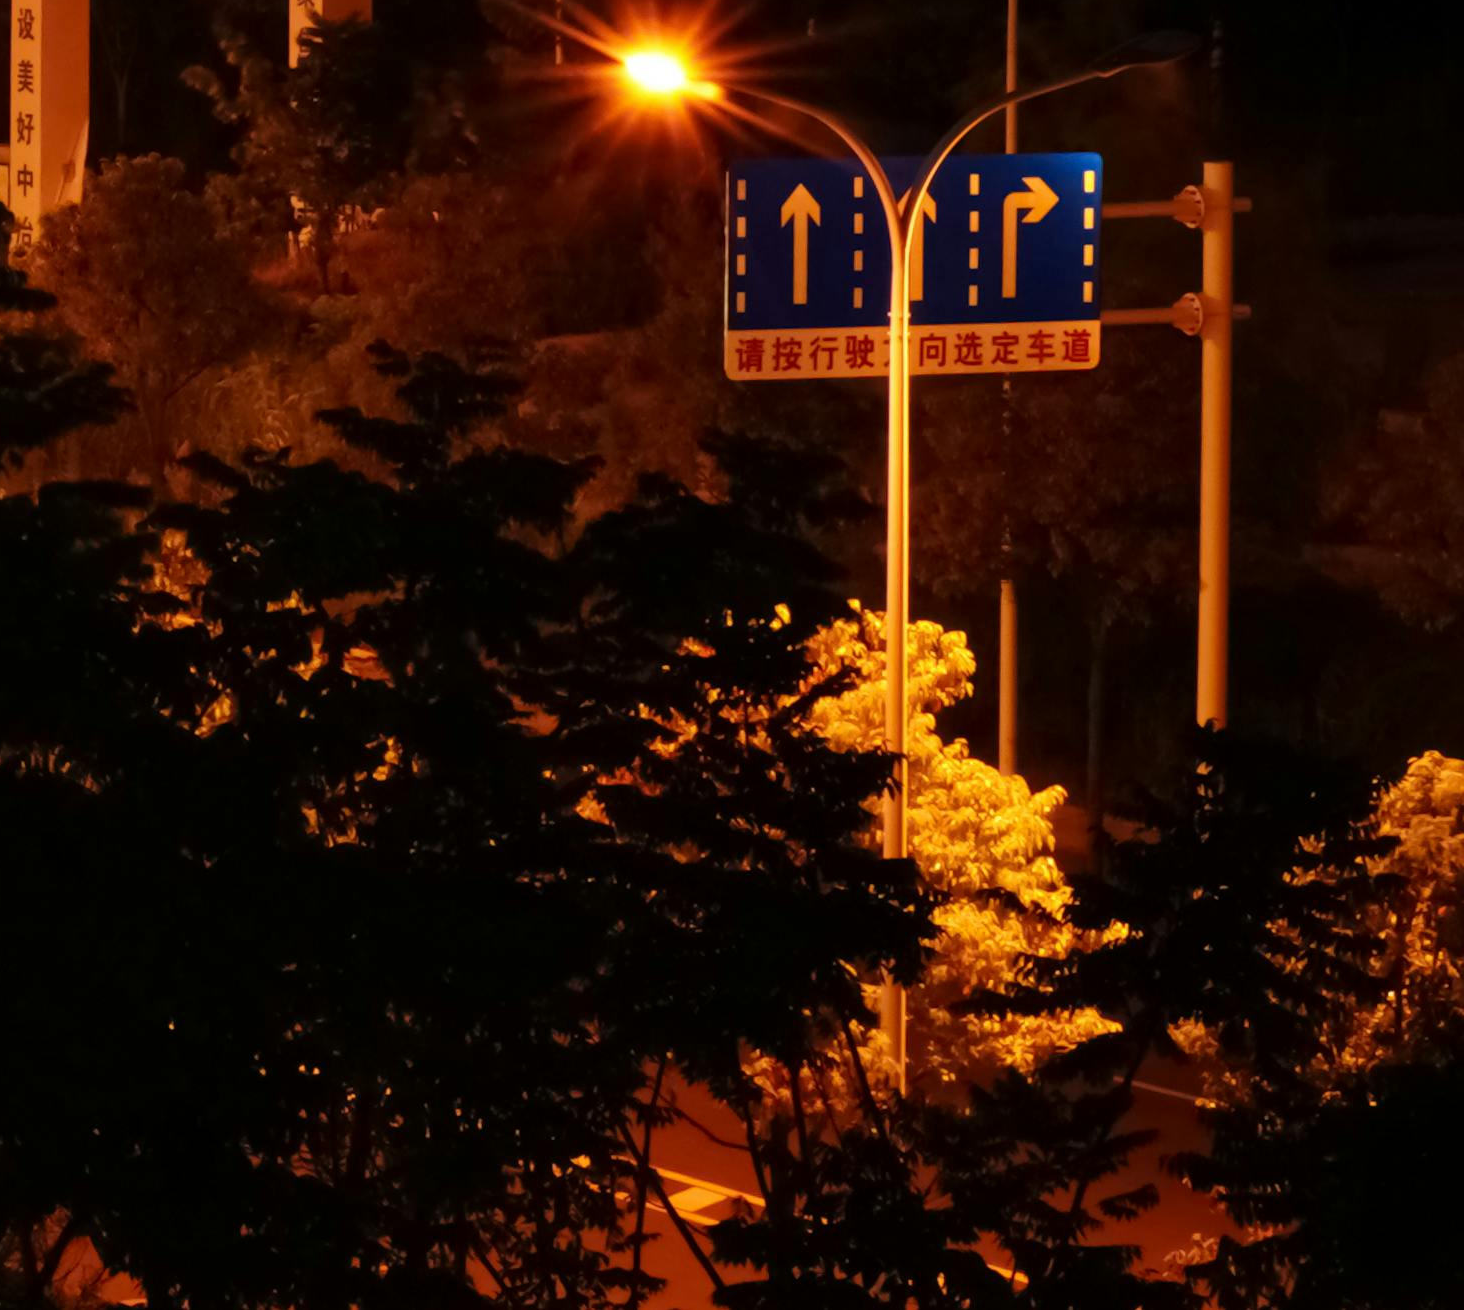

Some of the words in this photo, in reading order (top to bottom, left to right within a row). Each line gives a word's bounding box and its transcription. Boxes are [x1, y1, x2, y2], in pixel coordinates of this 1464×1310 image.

[735, 329, 1092, 373] 请按行驶向选定车道
